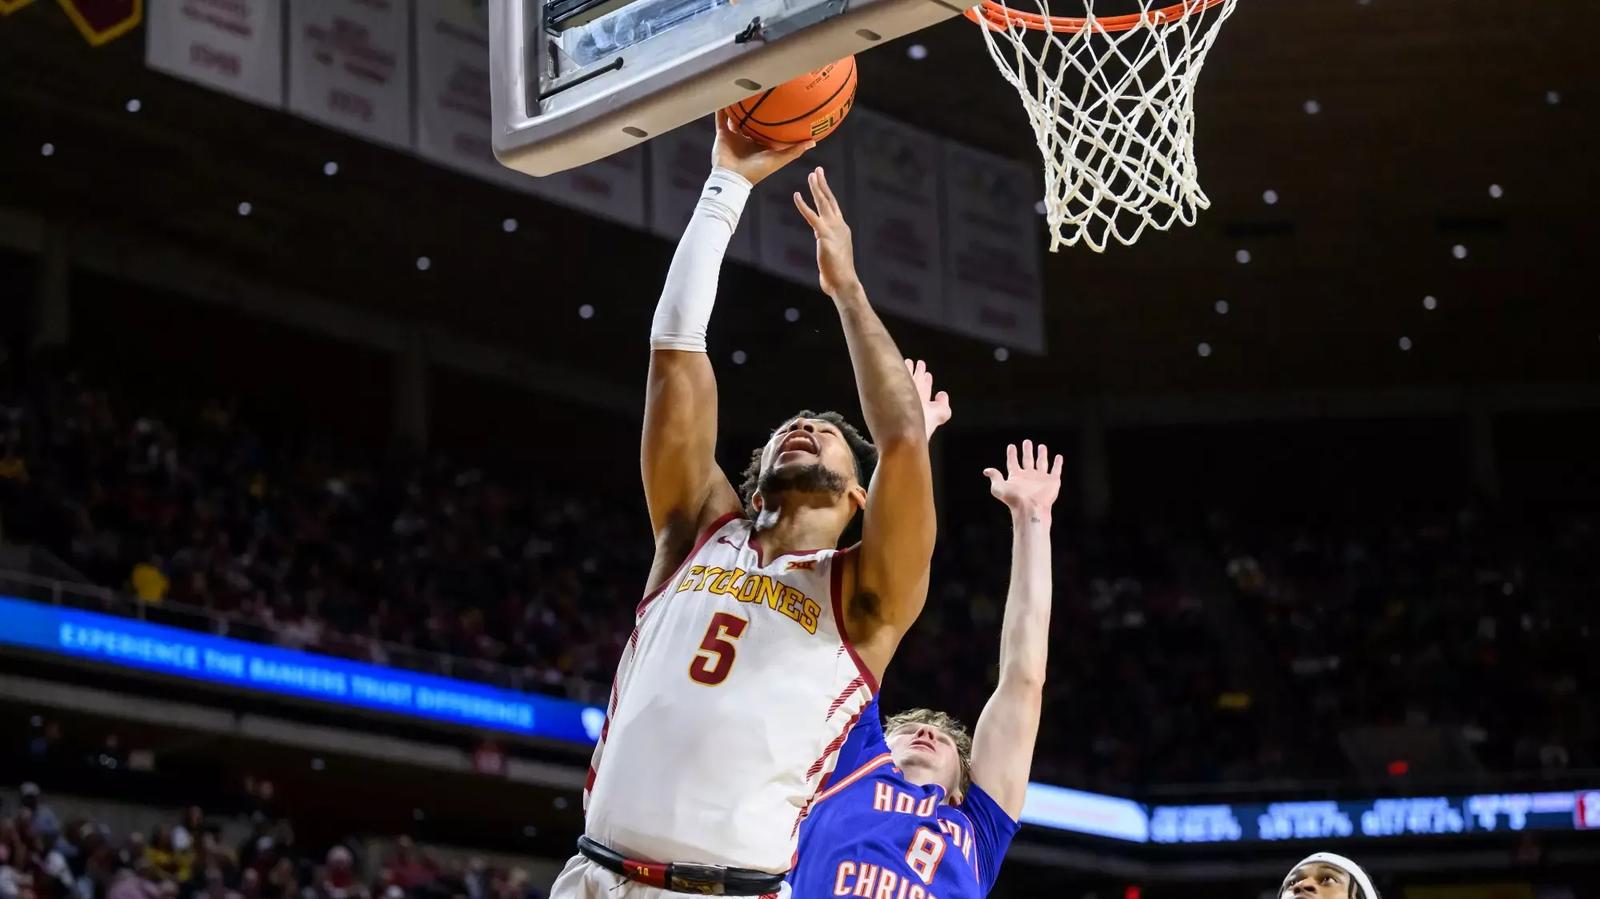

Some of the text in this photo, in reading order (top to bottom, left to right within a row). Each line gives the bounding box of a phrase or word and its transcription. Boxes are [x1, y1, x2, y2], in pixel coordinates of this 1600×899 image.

[676, 565, 822, 635] CYCLONES
[59, 622, 199, 671] EXPERIENCE
[203, 648, 245, 679] THE
[352, 674, 413, 706] TRUST
[688, 611, 749, 688] 5
[905, 826, 947, 885] 8
